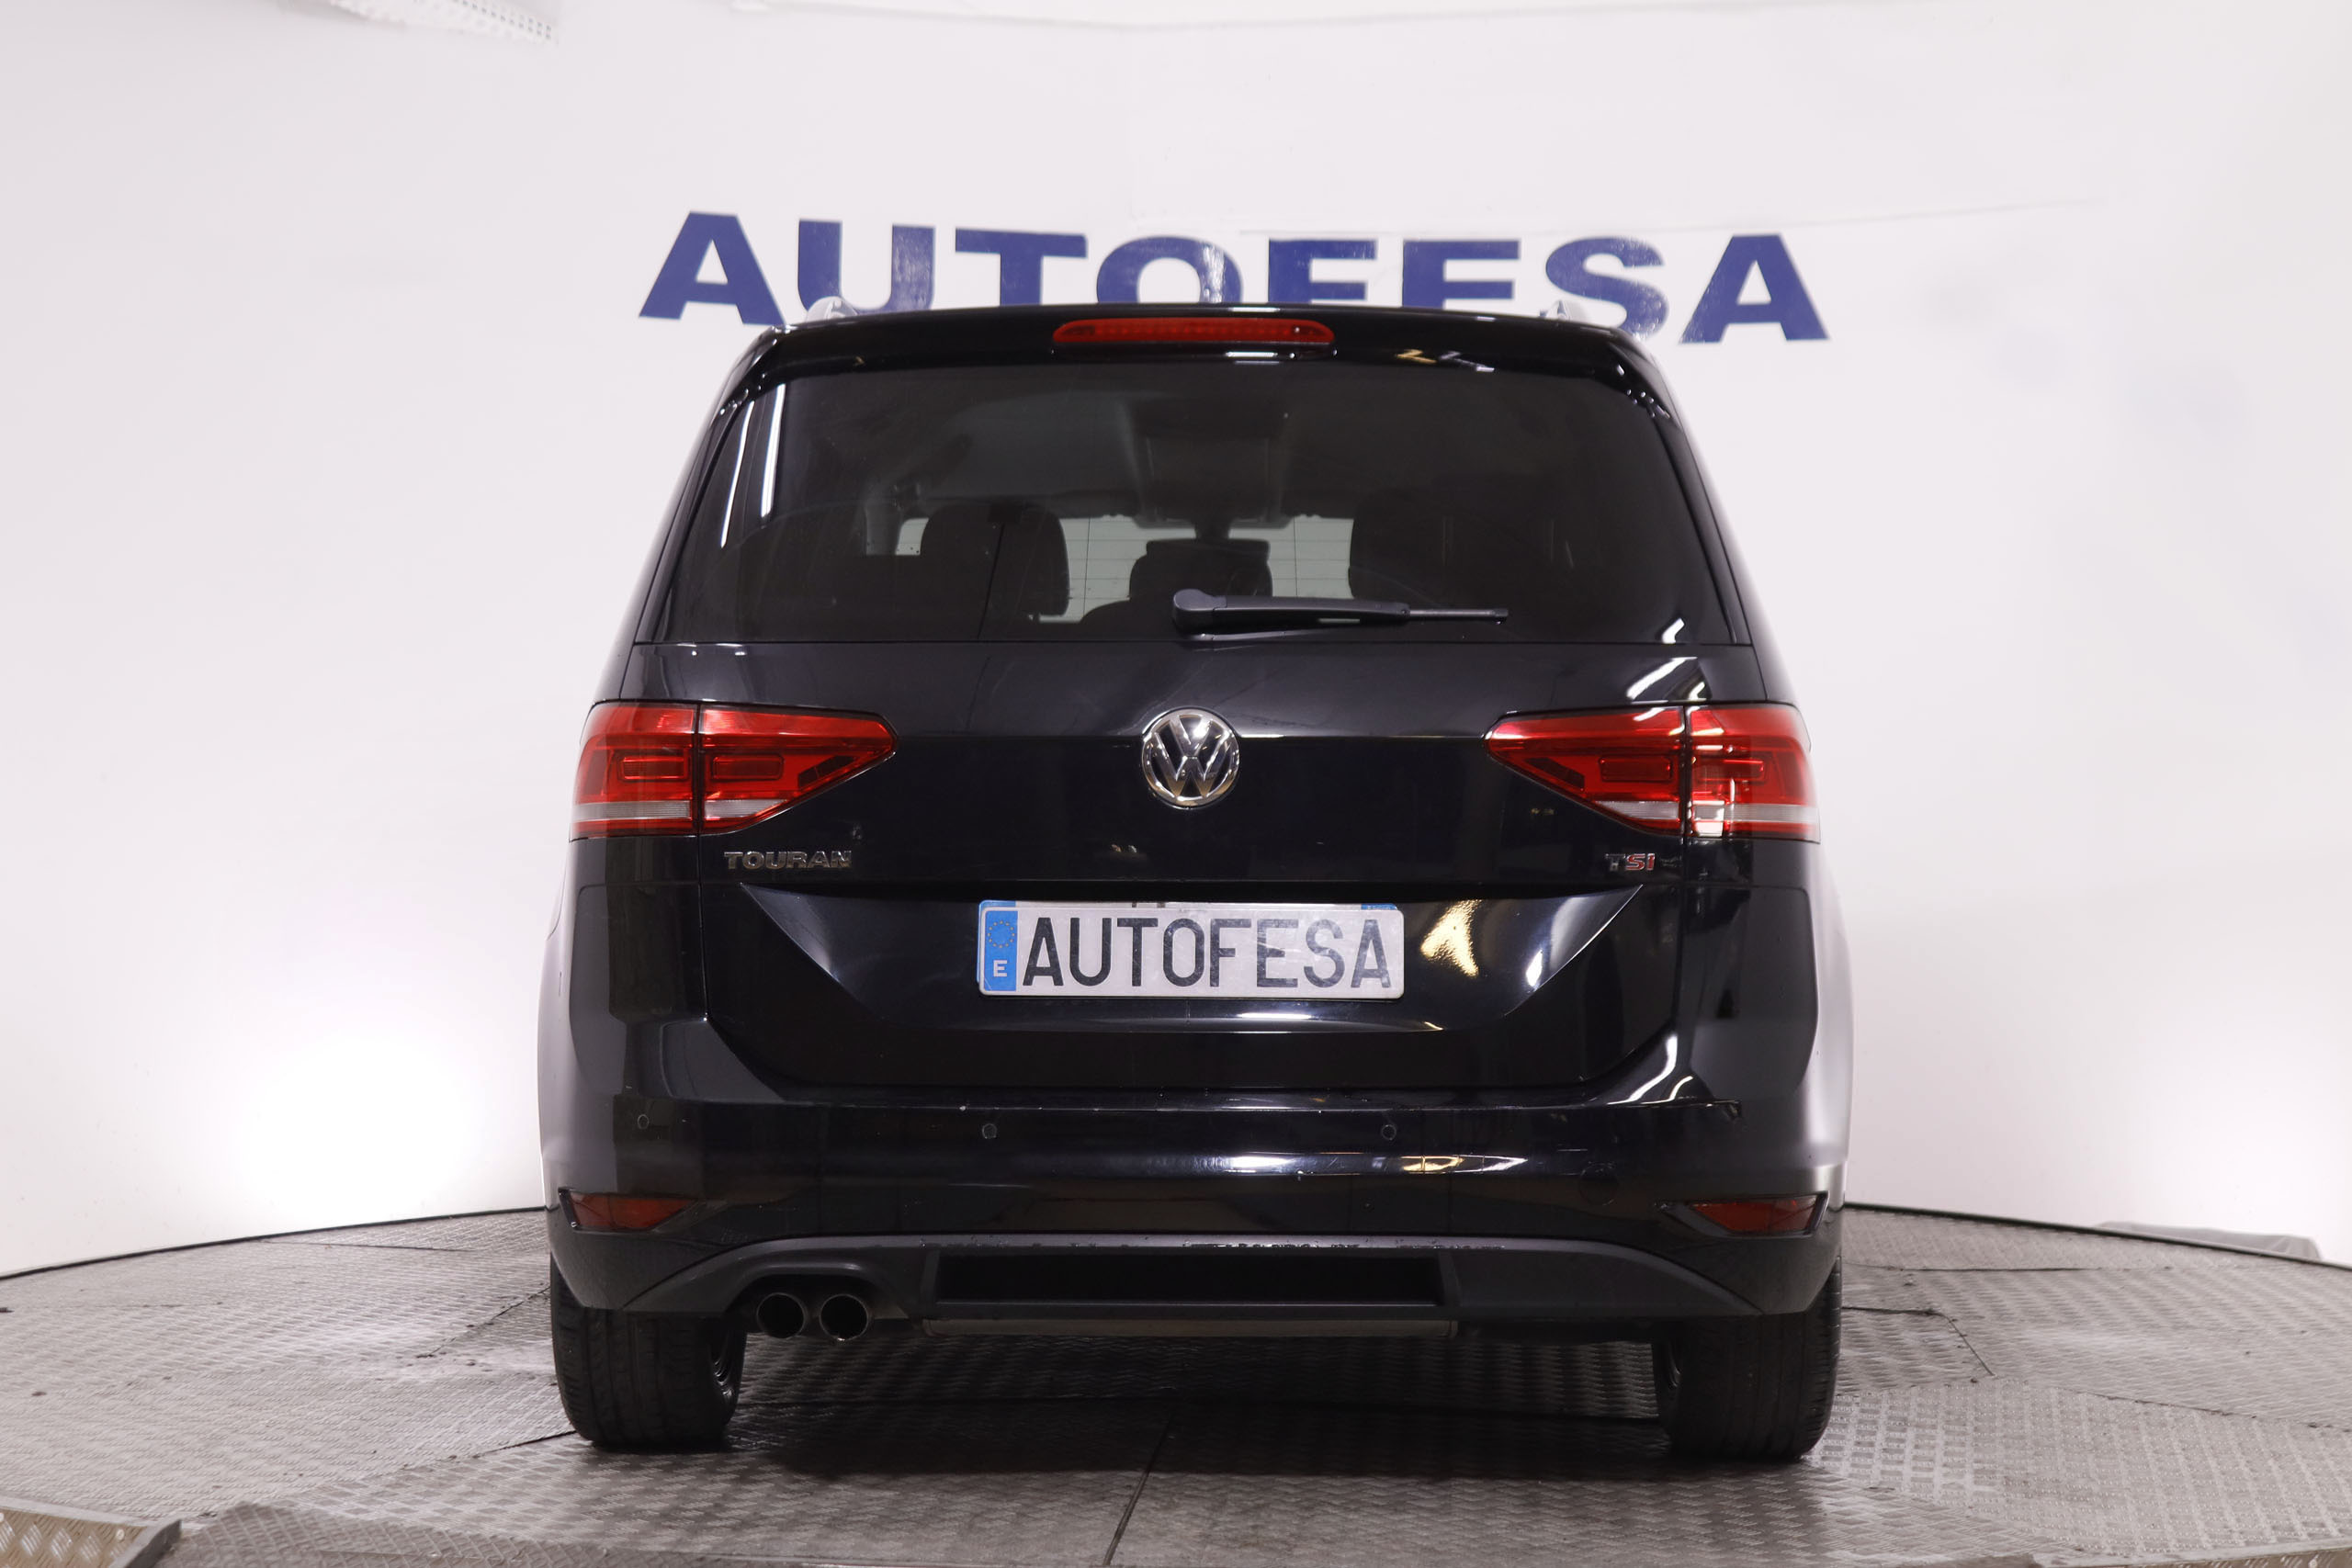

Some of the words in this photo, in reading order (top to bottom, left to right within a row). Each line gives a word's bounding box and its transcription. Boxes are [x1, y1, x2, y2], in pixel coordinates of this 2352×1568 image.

[638, 211, 1830, 344] AUTOFESA
[1147, 708, 1236, 805] VW
[723, 850, 852, 870] TOURAN
[993, 960, 1008, 977] E
[1022, 917, 1392, 988] AUTOFESA
